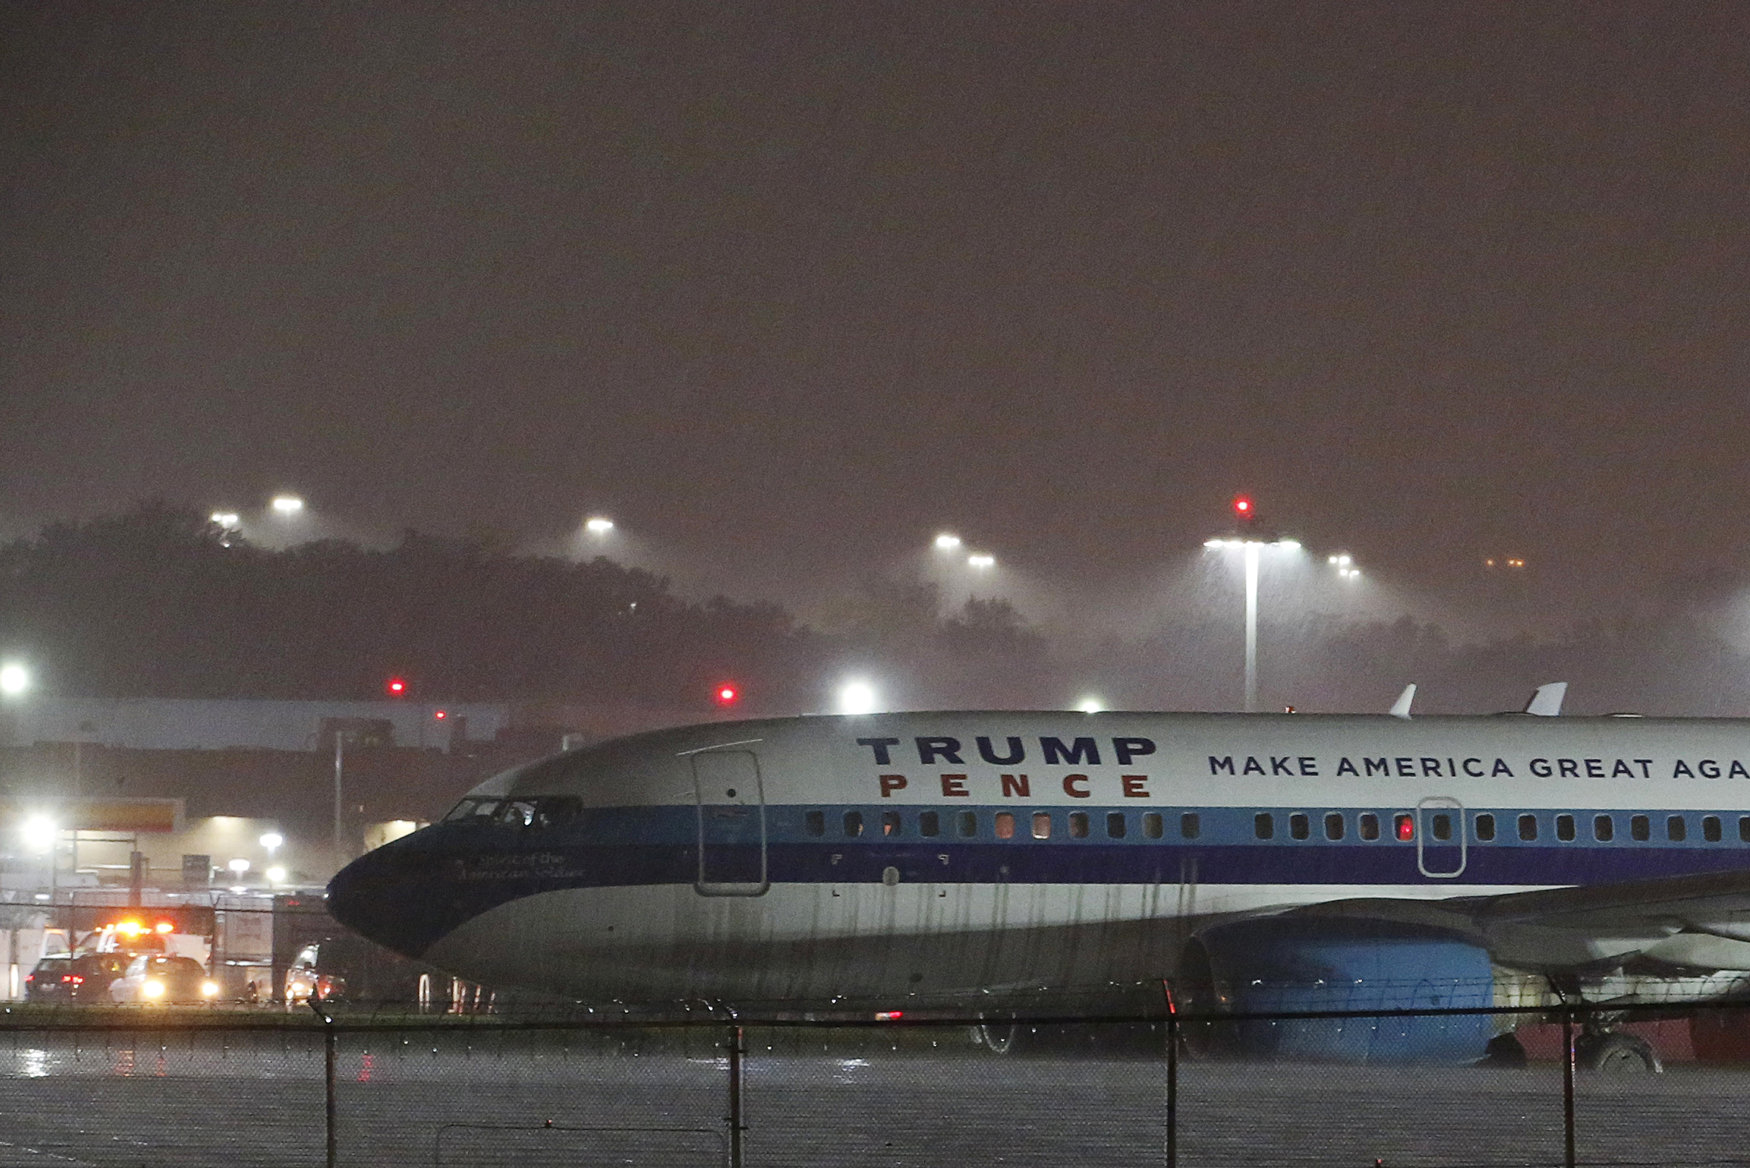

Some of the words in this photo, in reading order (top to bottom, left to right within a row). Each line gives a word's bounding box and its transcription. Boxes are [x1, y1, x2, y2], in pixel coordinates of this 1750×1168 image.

[856, 736, 1157, 765] TRUMP
[1208, 756, 1320, 777] MAKE
[1336, 757, 1514, 778] AMERICA
[1529, 757, 1653, 780] GREAT
[879, 774, 1151, 797] PENCE
